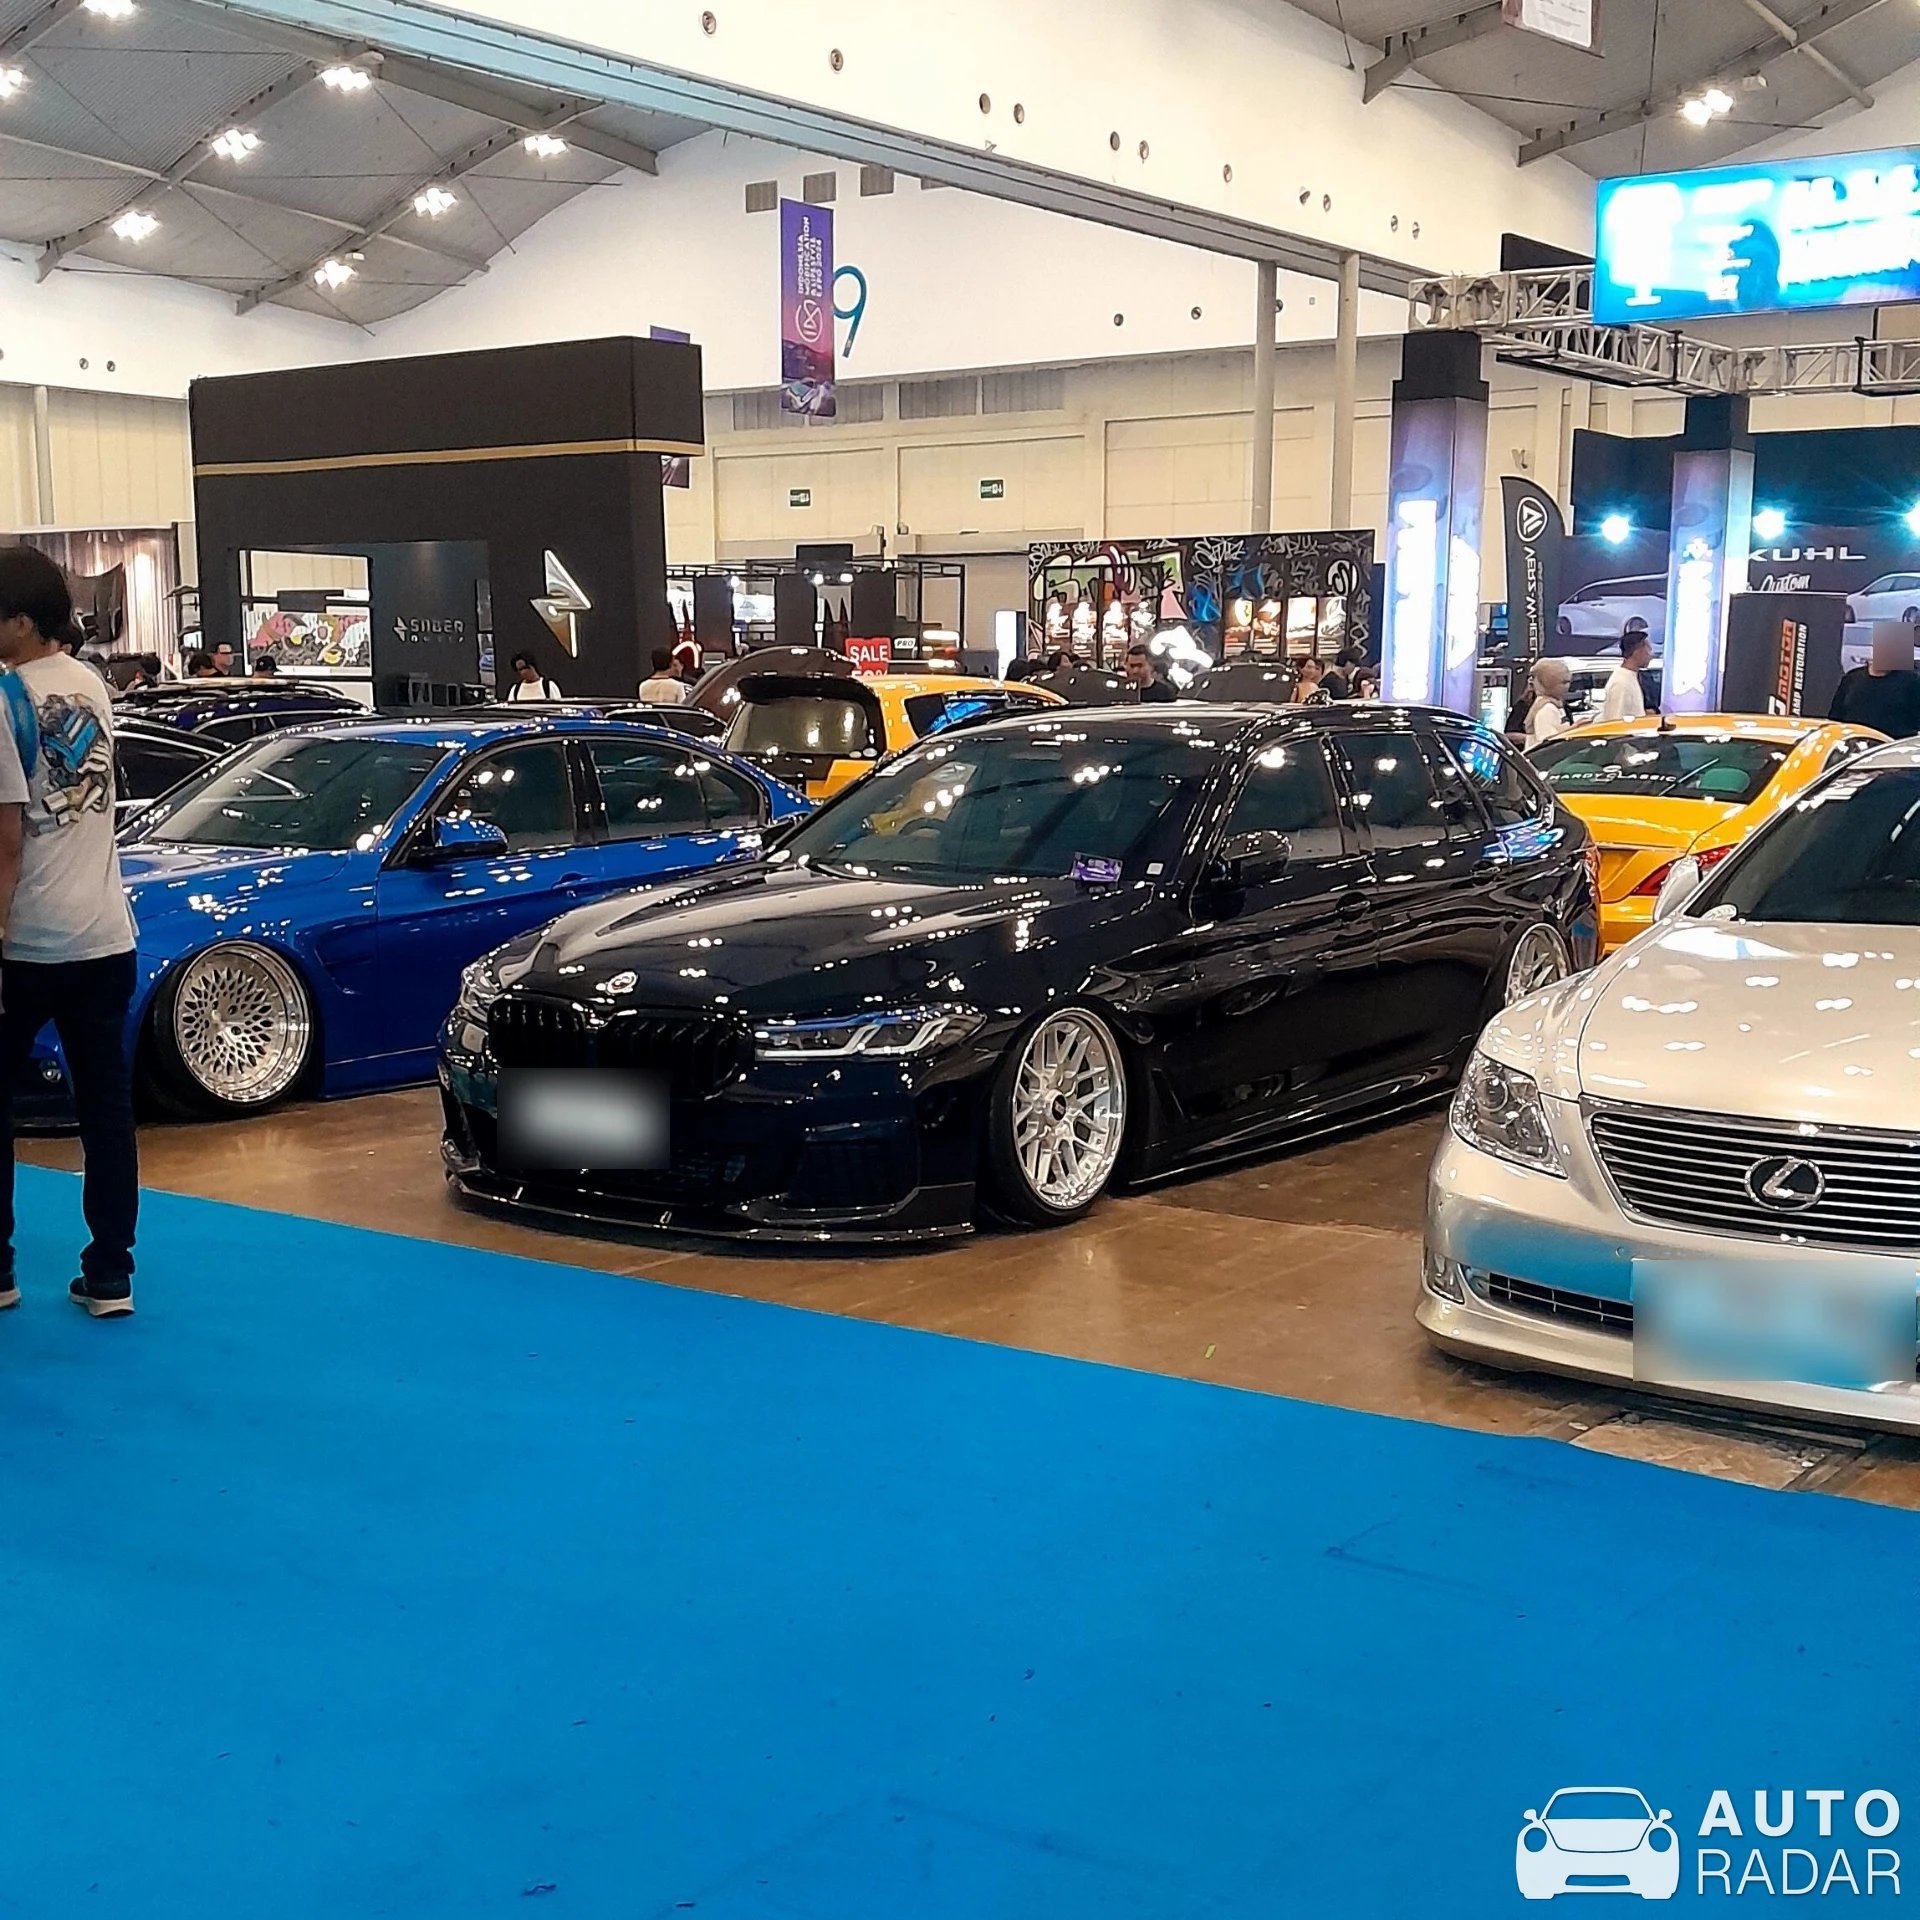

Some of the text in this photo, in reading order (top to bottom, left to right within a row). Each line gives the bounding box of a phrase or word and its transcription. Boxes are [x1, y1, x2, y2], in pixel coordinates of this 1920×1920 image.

[803, 217, 811, 295] MODIFICATION
[833, 265, 867, 358] 9
[1748, 546, 1867, 562] KUHL
[849, 644, 889, 662] SALE
[896, 639, 914, 647] PRO
[1794, 623, 1807, 691] RESTORATION
